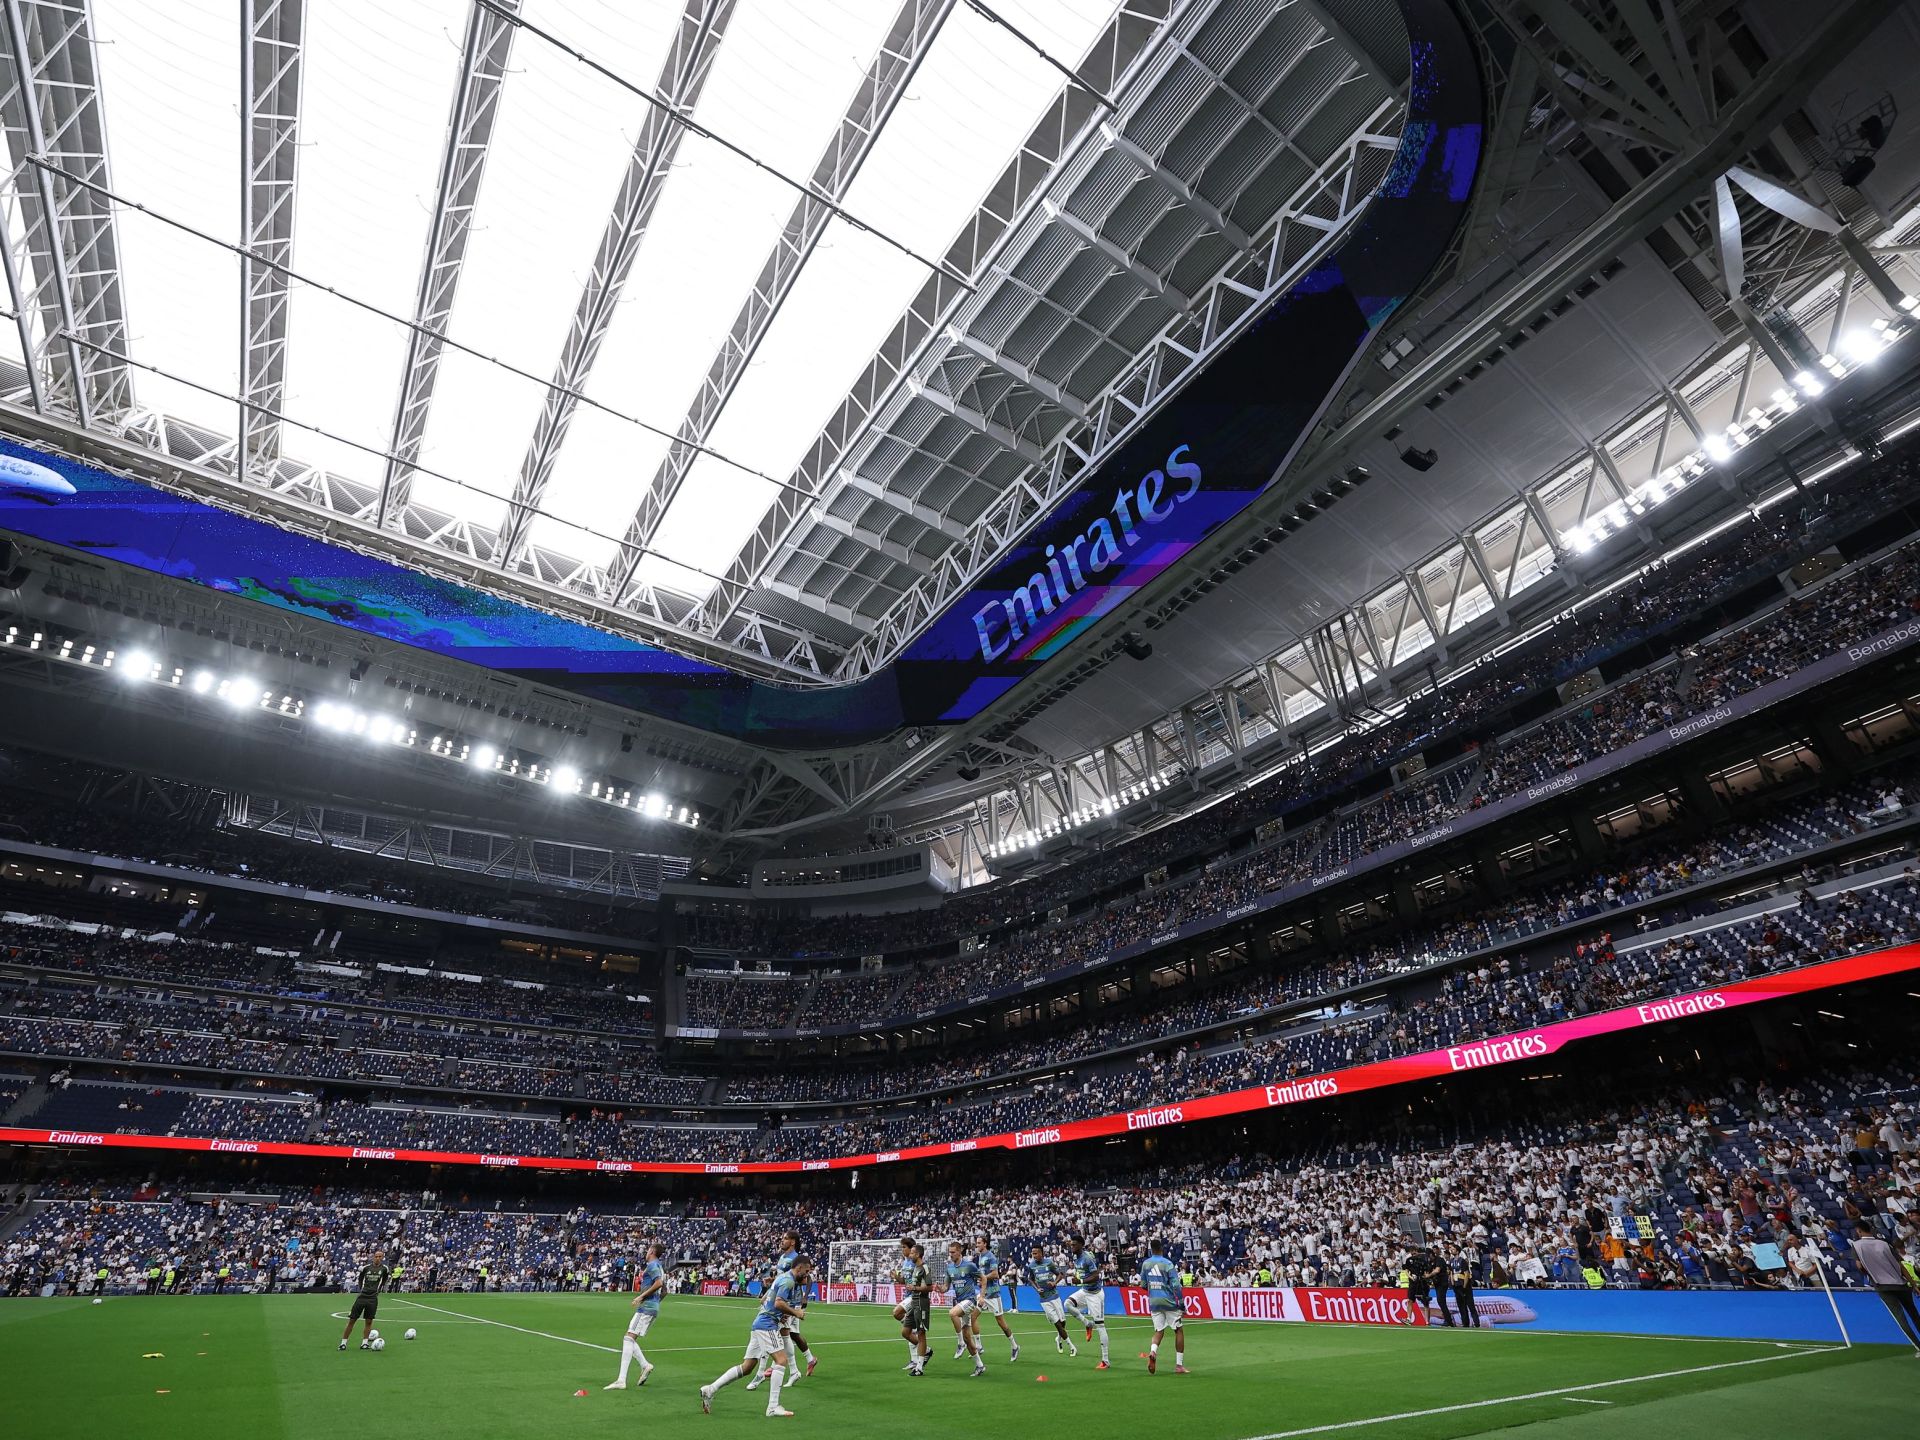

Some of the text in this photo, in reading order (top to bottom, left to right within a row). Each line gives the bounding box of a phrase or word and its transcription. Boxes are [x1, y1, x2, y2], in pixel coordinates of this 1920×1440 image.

[972, 444, 1201, 664] Emirates
[1847, 622, 1920, 661] Bernabé
[1669, 706, 1733, 739] Bernabéu
[1528, 772, 1578, 799] Bernabéu
[1411, 825, 1453, 848] Bernabéu
[1312, 867, 1348, 887] Bernabéu
[1226, 901, 1258, 919] Bernabéu
[1151, 930, 1179, 946] Bernabéu
[1084, 954, 1109, 969] Bernabéu
[1636, 991, 1726, 1024] Emirates
[1447, 1035, 1547, 1071] Emirates
[1265, 1077, 1338, 1106] Emirates
[1127, 1108, 1183, 1130] Emirates
[48, 1131, 103, 1145] Emirates
[210, 1140, 259, 1153] Emirates
[950, 1140, 977, 1153] Emirates
[1015, 1128, 1060, 1148] Emirates
[352, 1147, 396, 1160] Emirates
[480, 1154, 520, 1167] Emirates
[876, 1152, 900, 1163] Emirates
[596, 1160, 633, 1172] Emirates
[705, 1164, 739, 1174] Emirates
[802, 1160, 830, 1171] Emirates
[703, 1282, 727, 1296] Emirates
[1221, 1291, 1285, 1319] FLY BETTER
[1308, 1290, 1416, 1324] Emirates
